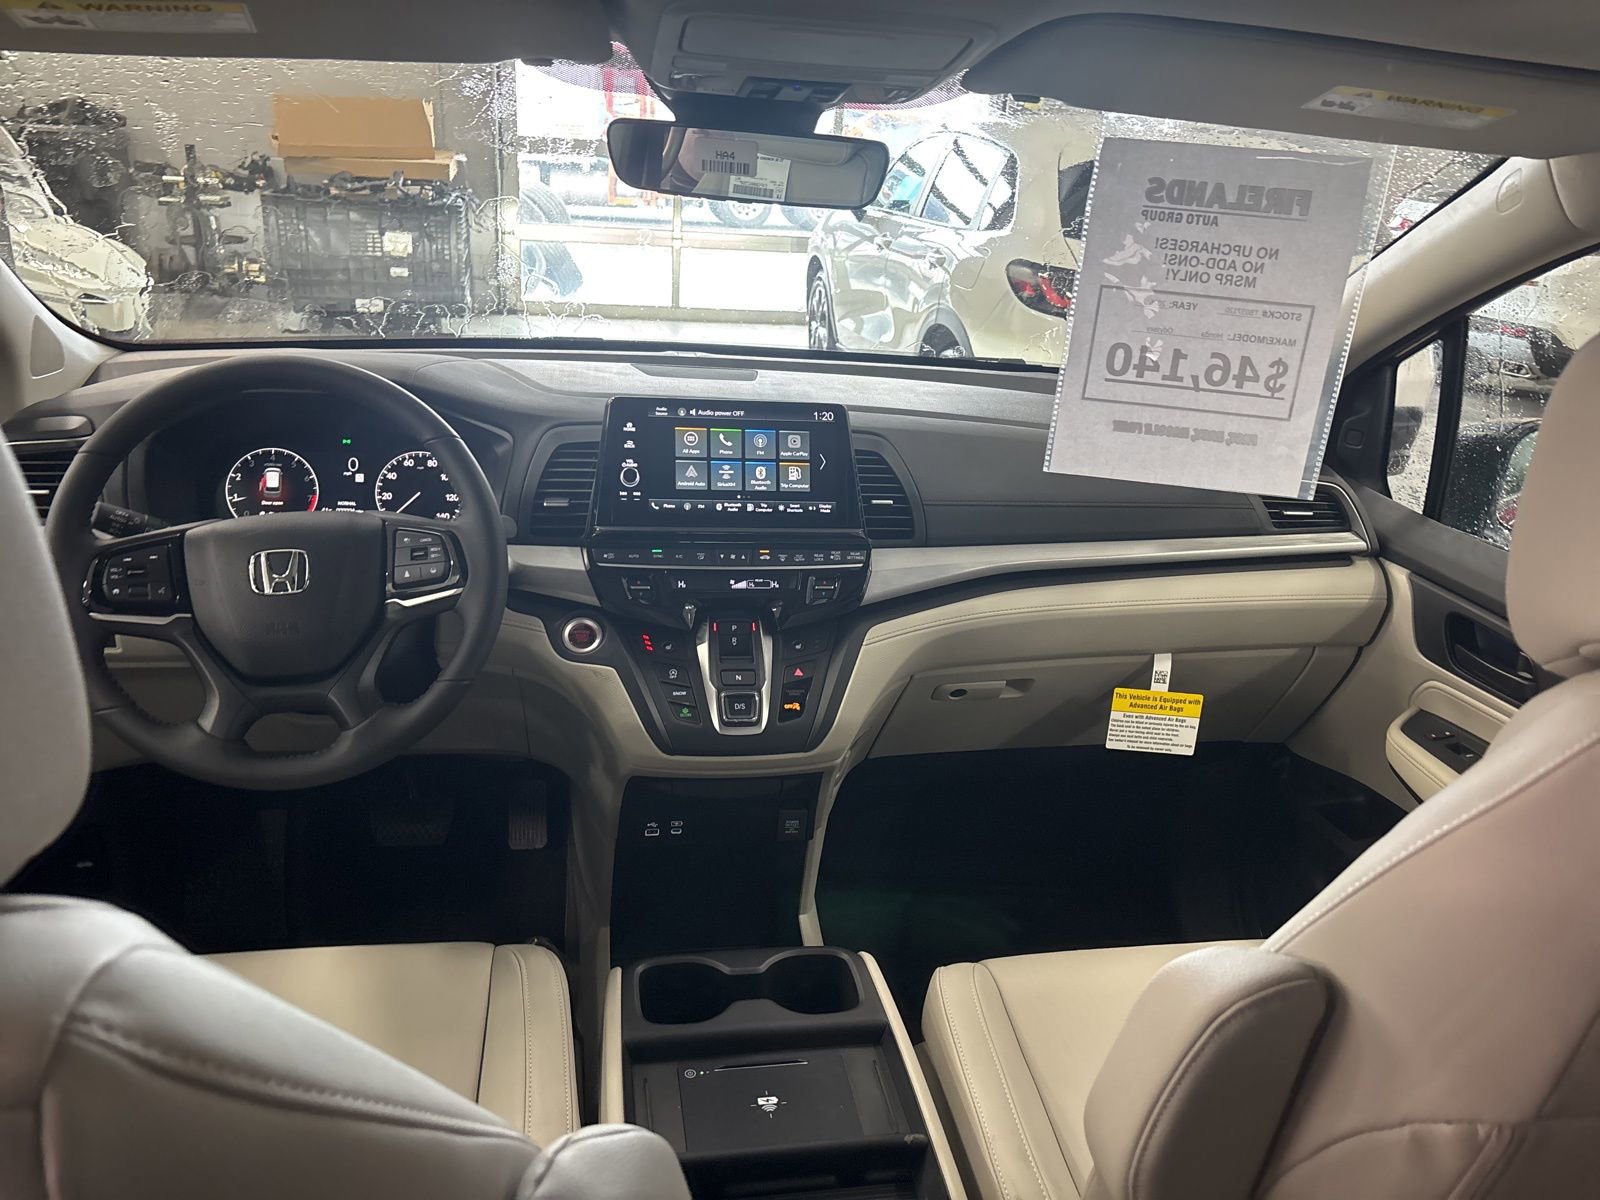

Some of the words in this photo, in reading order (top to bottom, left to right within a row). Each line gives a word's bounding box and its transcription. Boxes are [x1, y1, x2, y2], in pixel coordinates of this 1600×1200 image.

[77, 2, 212, 12] WARNING
[813, 412, 834, 421] 1:20
[348, 457, 359, 471] 0
[386, 472, 397, 480] 40
[1159, 696, 1186, 705] Equipped
[1129, 702, 1157, 710] Advanced
[1169, 705, 1184, 713] Bags
